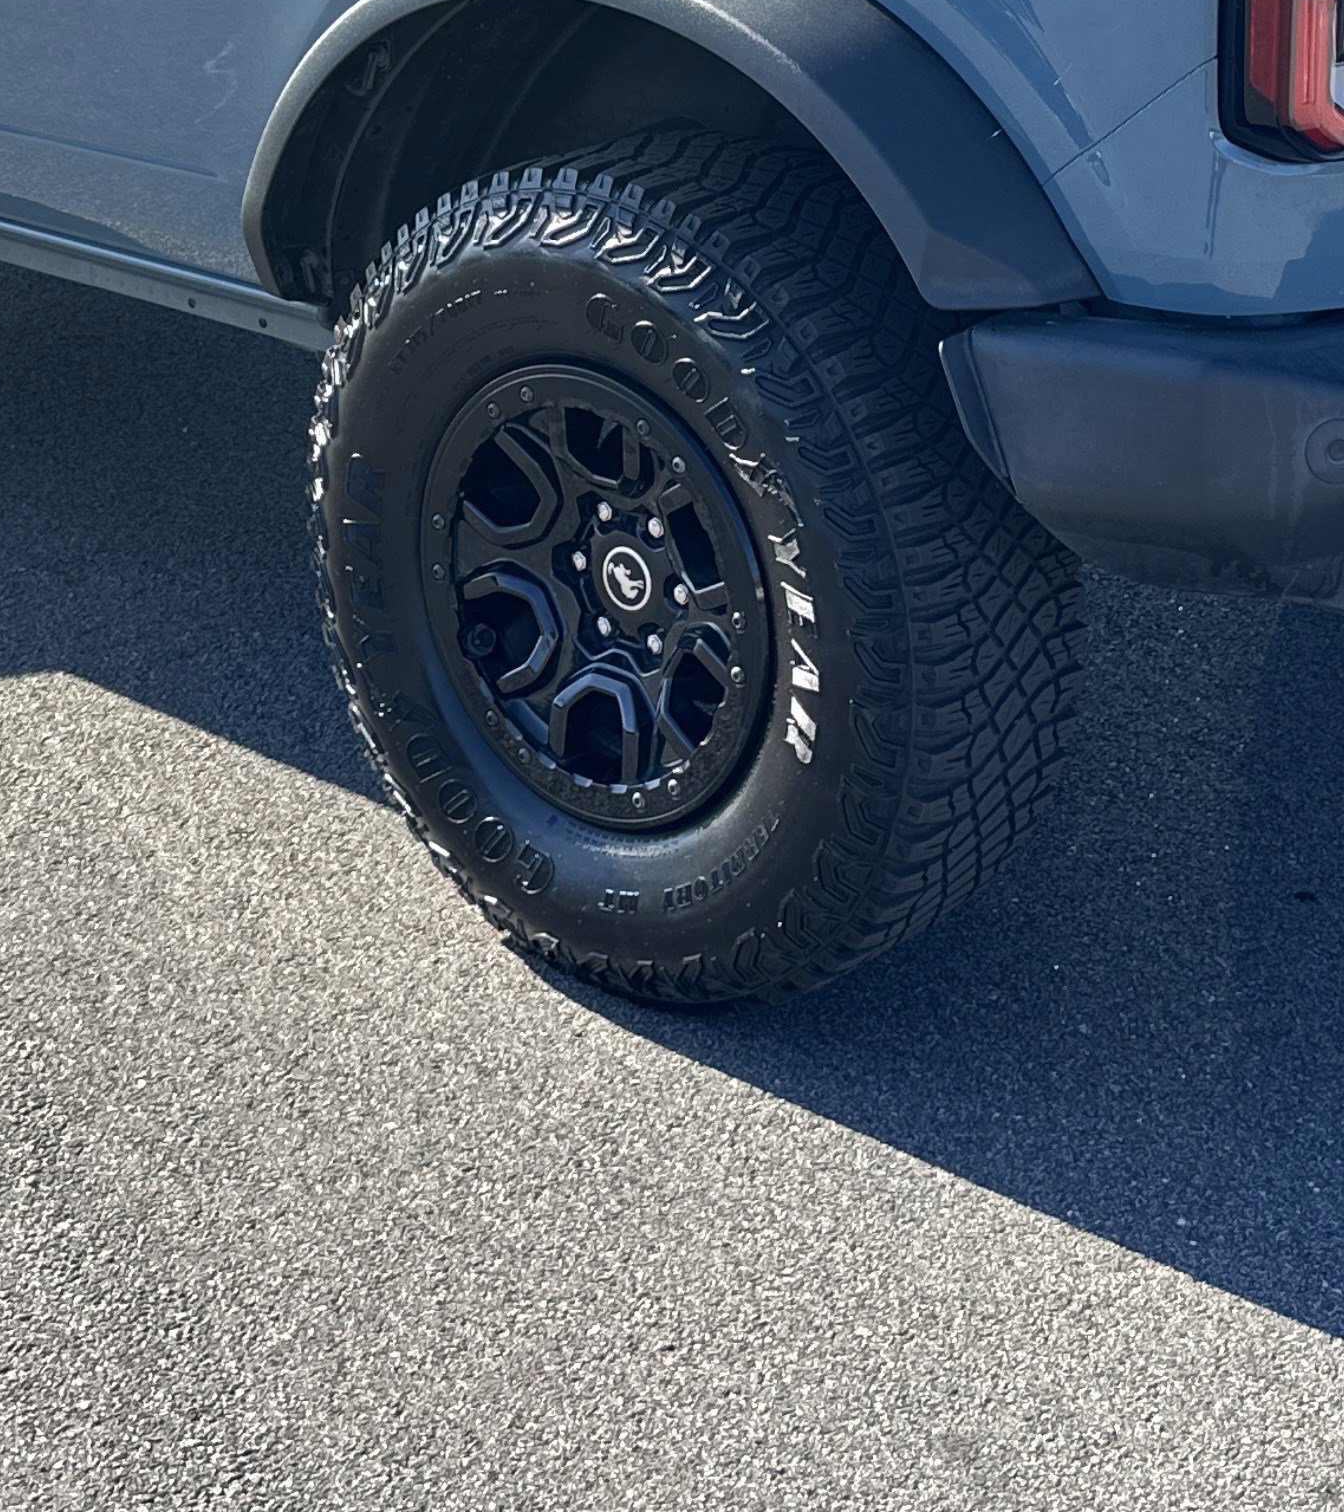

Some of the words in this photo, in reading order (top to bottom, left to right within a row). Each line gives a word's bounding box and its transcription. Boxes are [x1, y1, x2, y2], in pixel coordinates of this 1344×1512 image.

[342, 451, 557, 896] GOODYEAR
[585, 292, 824, 765] GOODYEAR
[662, 808, 782, 912] TERRITORY
